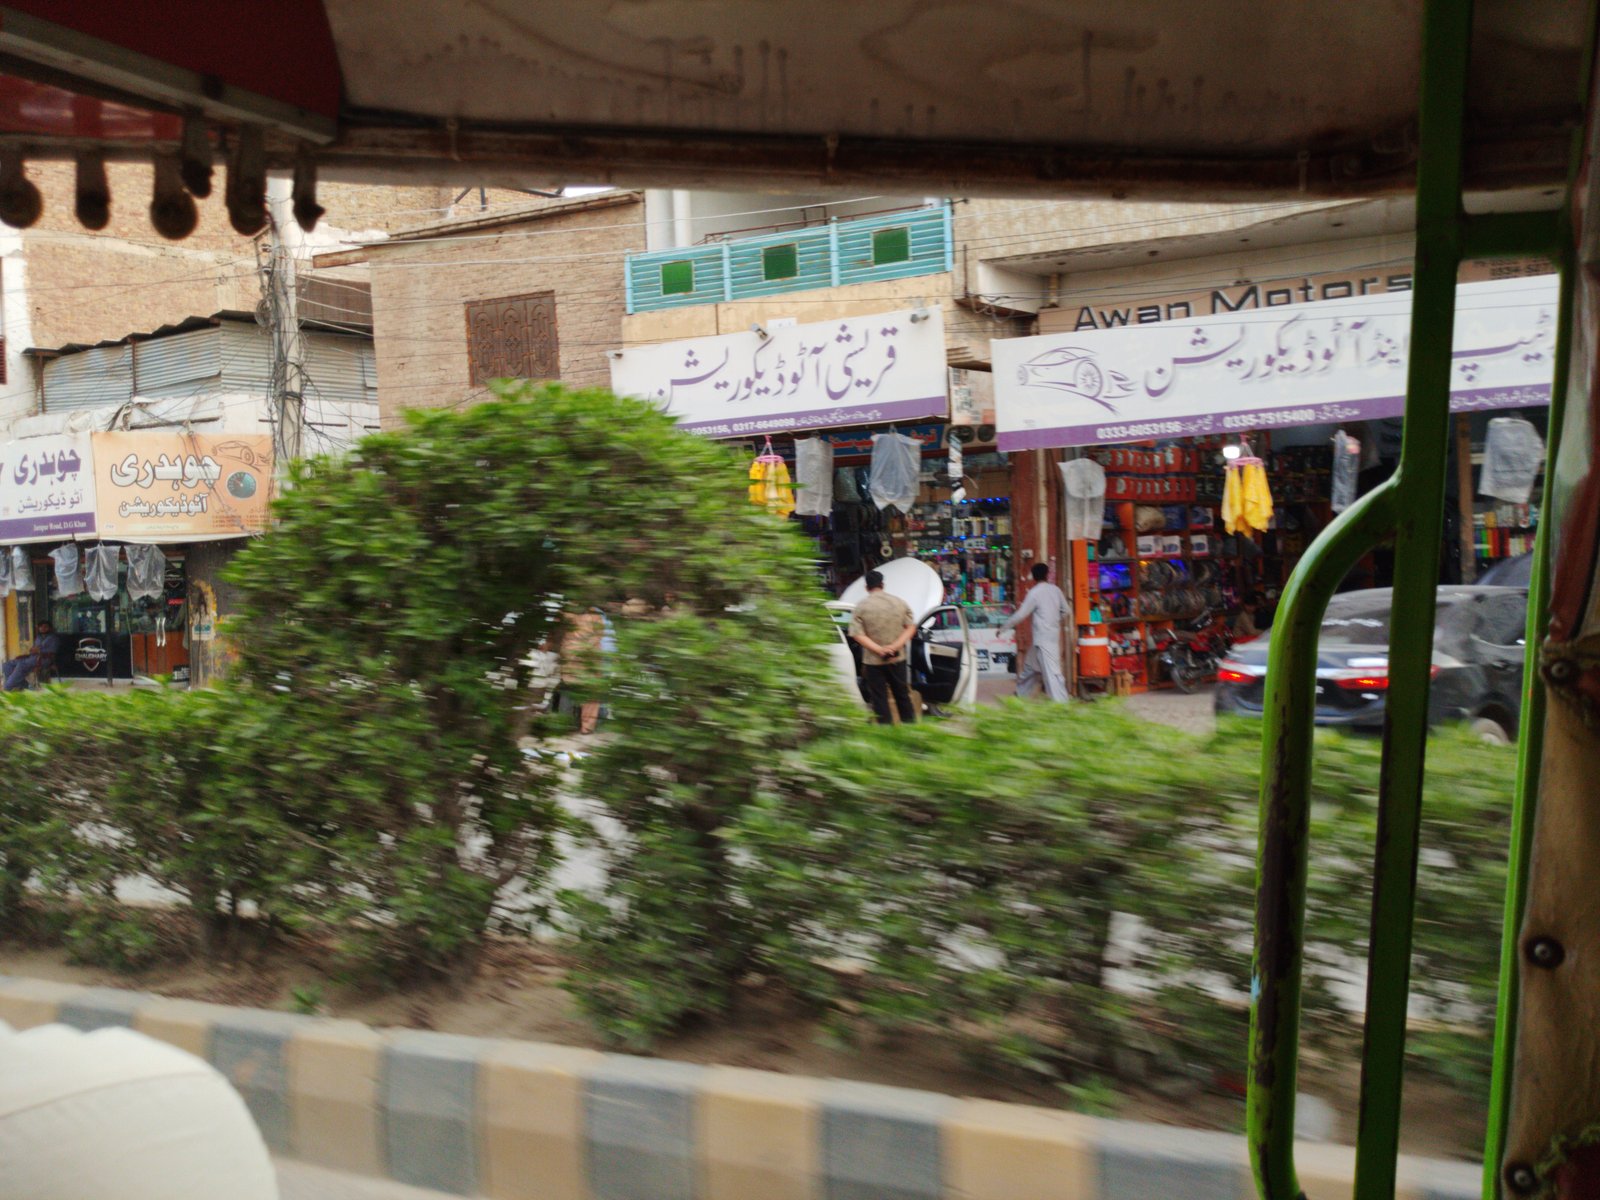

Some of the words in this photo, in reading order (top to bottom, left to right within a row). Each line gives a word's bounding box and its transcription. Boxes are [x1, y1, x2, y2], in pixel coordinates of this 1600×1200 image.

[1073, 301, 1190, 332] Awan
[1211, 273, 1413, 313] Motors
[826, 324, 898, 400] قریشی
[14, 448, 82, 486] چوہدری
[111, 453, 222, 490] چوہدری
